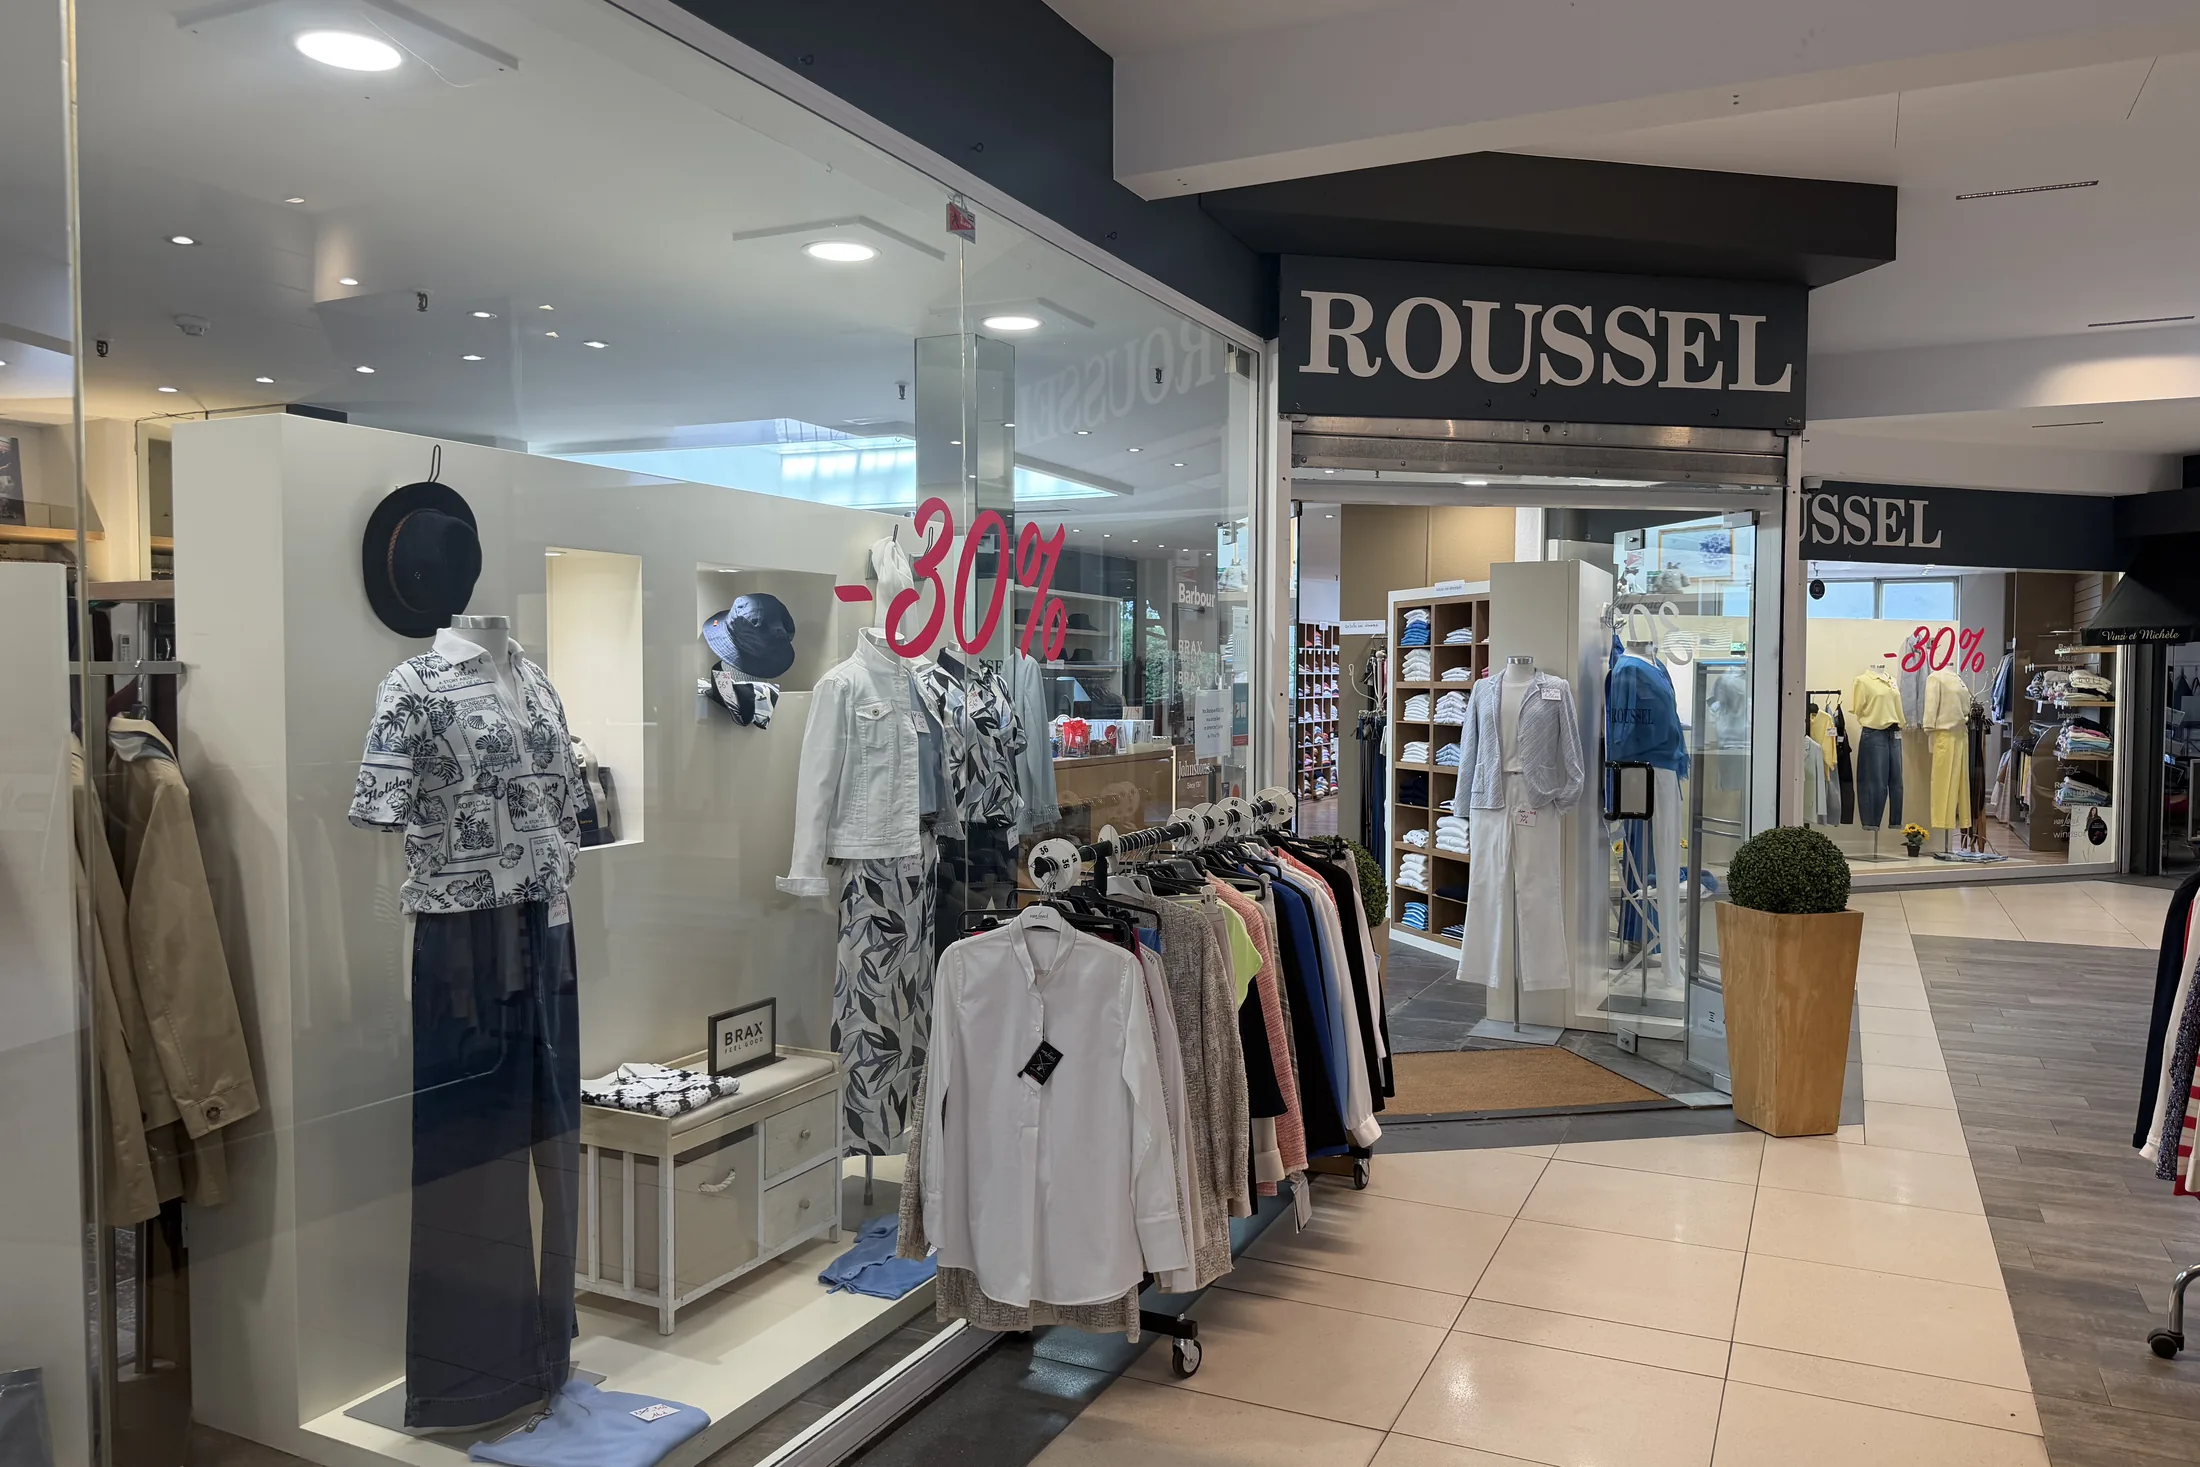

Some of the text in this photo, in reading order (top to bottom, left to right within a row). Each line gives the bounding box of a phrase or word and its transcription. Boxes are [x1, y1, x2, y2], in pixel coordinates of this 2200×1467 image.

[1299, 290, 1793, 393] ROUSSEL
[834, 497, 1067, 661] -30%
[1178, 582, 1215, 607] Barbour
[1883, 626, 1985, 673] -30%
[454, 668, 479, 678] DREAM
[364, 776, 413, 805] Holiday
[1039, 844, 1050, 856] 36
[1061, 858, 1071, 870] 36
[724, 1021, 764, 1047] BRAX
[724, 1036, 764, 1055] FEEL GOOD
